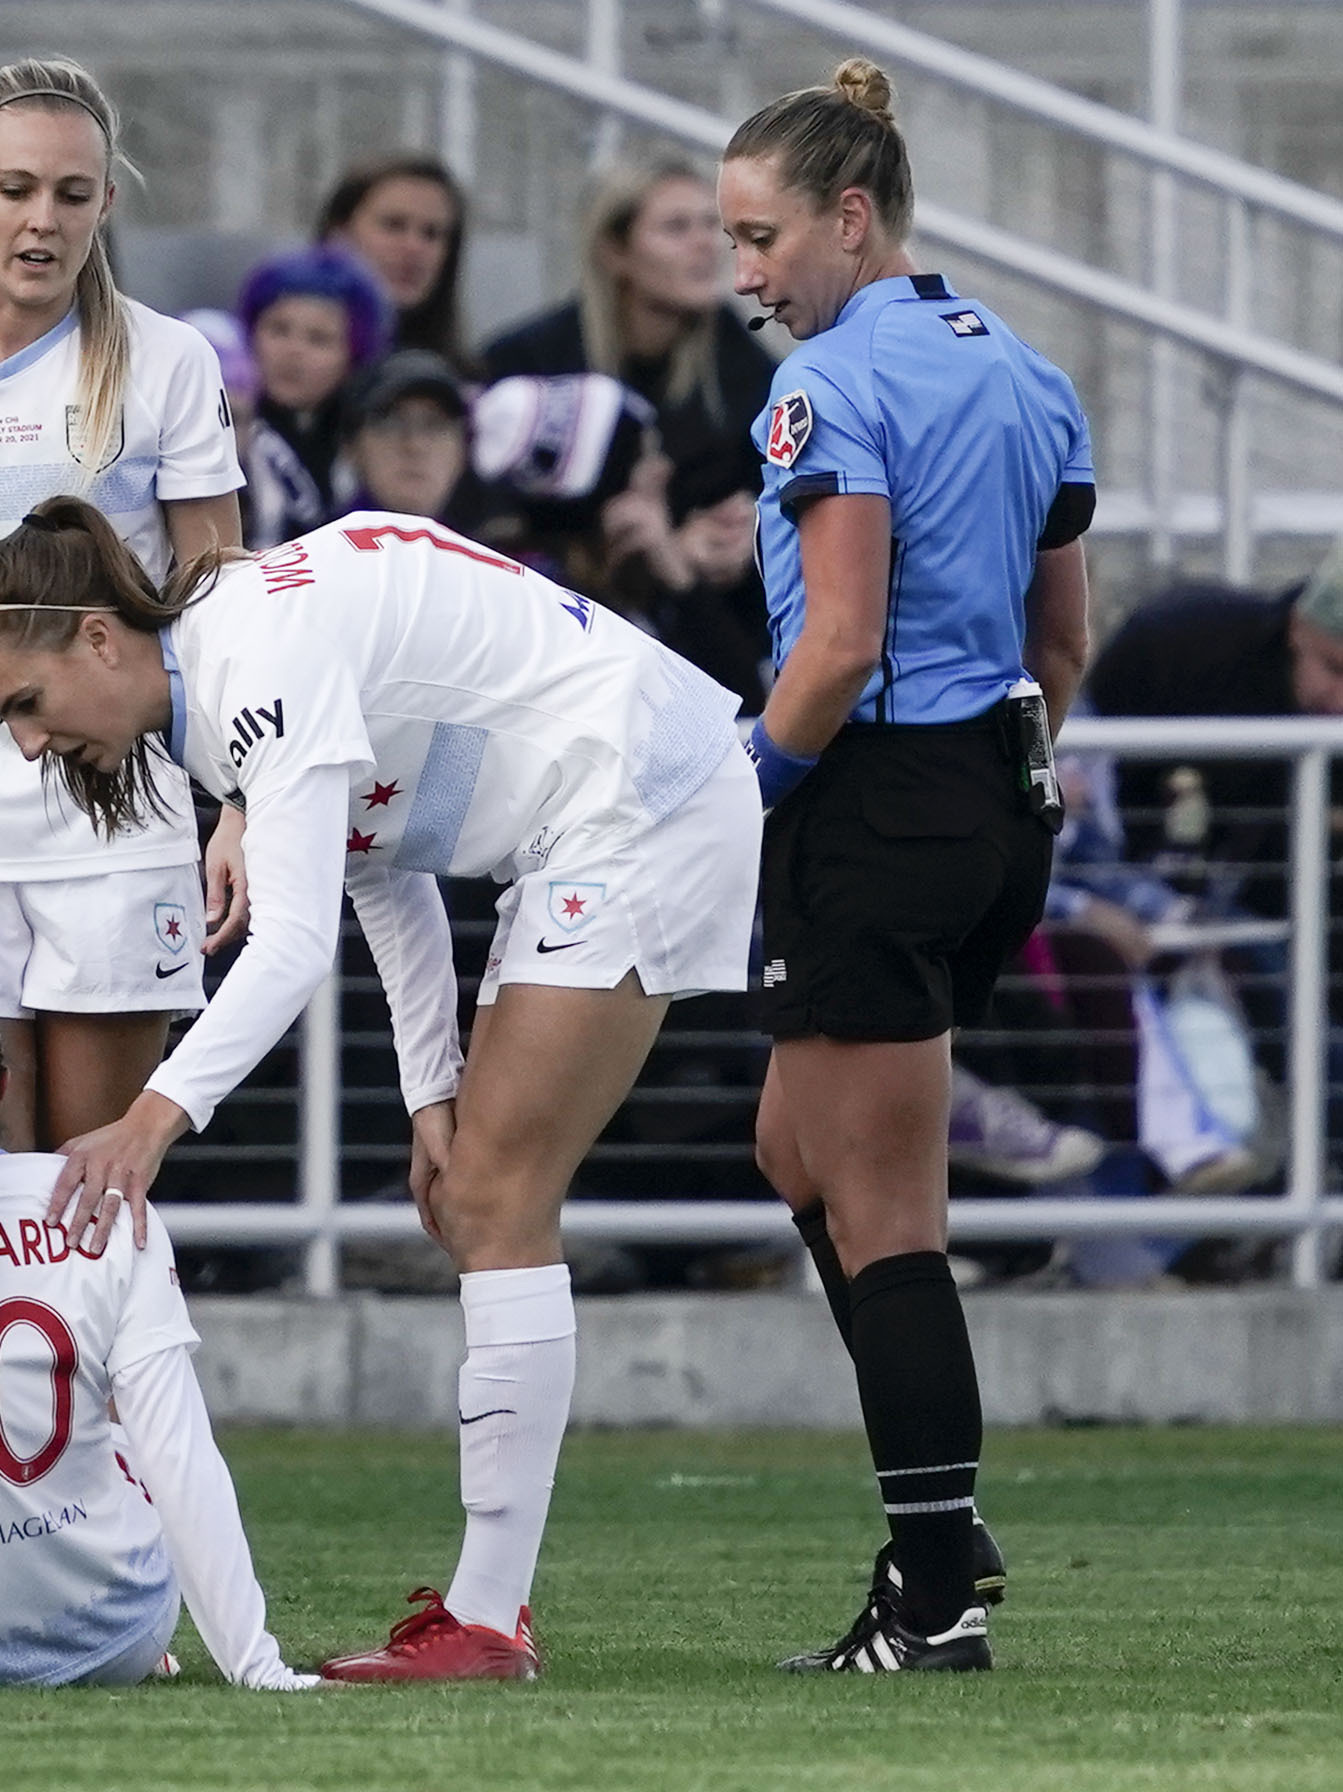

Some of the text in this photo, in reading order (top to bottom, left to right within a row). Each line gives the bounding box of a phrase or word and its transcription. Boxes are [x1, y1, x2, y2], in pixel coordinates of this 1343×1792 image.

[8, 424, 43, 433] STADIUM
[19, 433, 39, 442] 2021
[229, 698, 284, 769] ally
